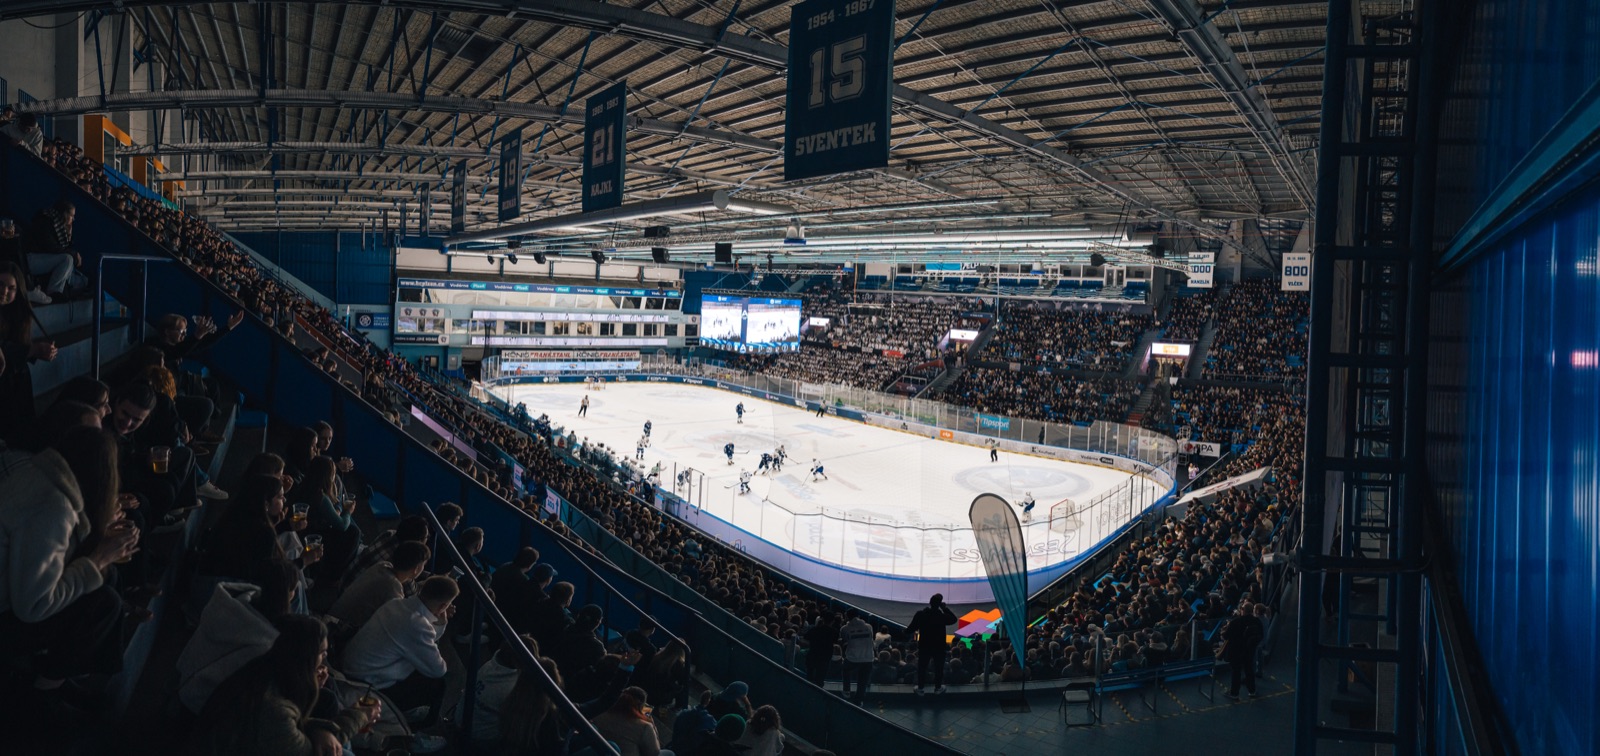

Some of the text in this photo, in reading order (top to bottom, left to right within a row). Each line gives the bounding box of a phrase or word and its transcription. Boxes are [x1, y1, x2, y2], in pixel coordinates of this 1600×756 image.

[808, 10, 834, 30] 1954
[845, 0, 875, 17] 1967
[808, 34, 867, 110] 15
[592, 123, 614, 168] 21
[795, 122, 876, 156] SVENTEK
[1284, 266, 1308, 276] 800
[982, 417, 1010, 428] Tipsport
